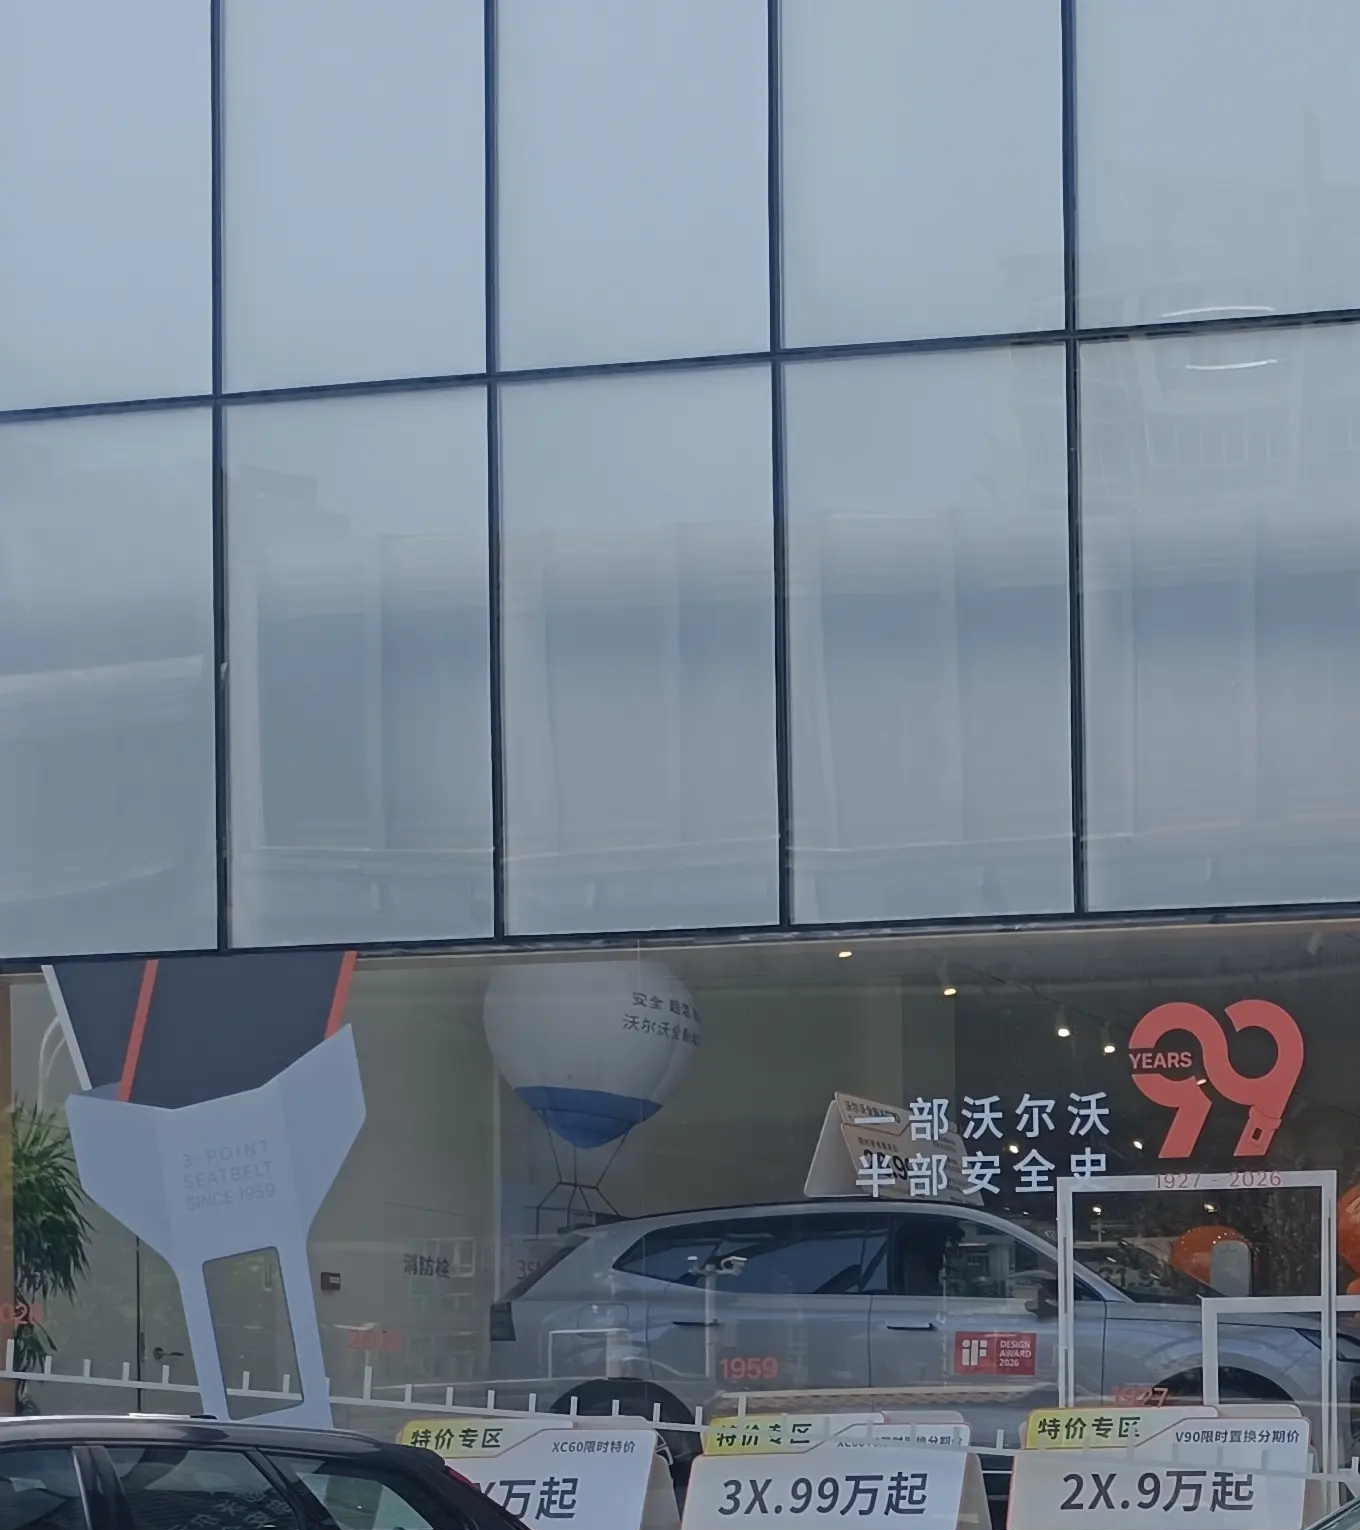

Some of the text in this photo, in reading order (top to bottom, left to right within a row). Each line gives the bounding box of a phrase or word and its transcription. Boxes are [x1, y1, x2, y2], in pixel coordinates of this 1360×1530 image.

[1128, 1051, 1193, 1070] YEARS
[1128, 999, 1304, 1159] 99
[854, 1092, 1110, 1141] 一部沃尔沃
[183, 1160, 275, 1190] SEATBELT
[855, 1147, 1107, 1198] 半部安全史
[1155, 1173, 1201, 1189] 1927
[1229, 1171, 1282, 1188] 2026
[186, 1182, 275, 1212] SINCE 1959
[402, 1253, 451, 1279] 消防栓
[999, 1349, 1032, 1358] AWARD
[1000, 1340, 1031, 1349] DESIGN
[718, 1356, 779, 1380] 1959
[998, 1358, 1020, 1367] 2026
[410, 1427, 504, 1450] 特价专区
[1037, 1416, 1141, 1440] 特价专区
[1175, 1429, 1300, 1444] V90限时置换分期价
[551, 1440, 636, 1454] XC60限时特价
[717, 1471, 928, 1517] 3X.99万起
[1060, 1470, 1254, 1513] 2X.9万起
